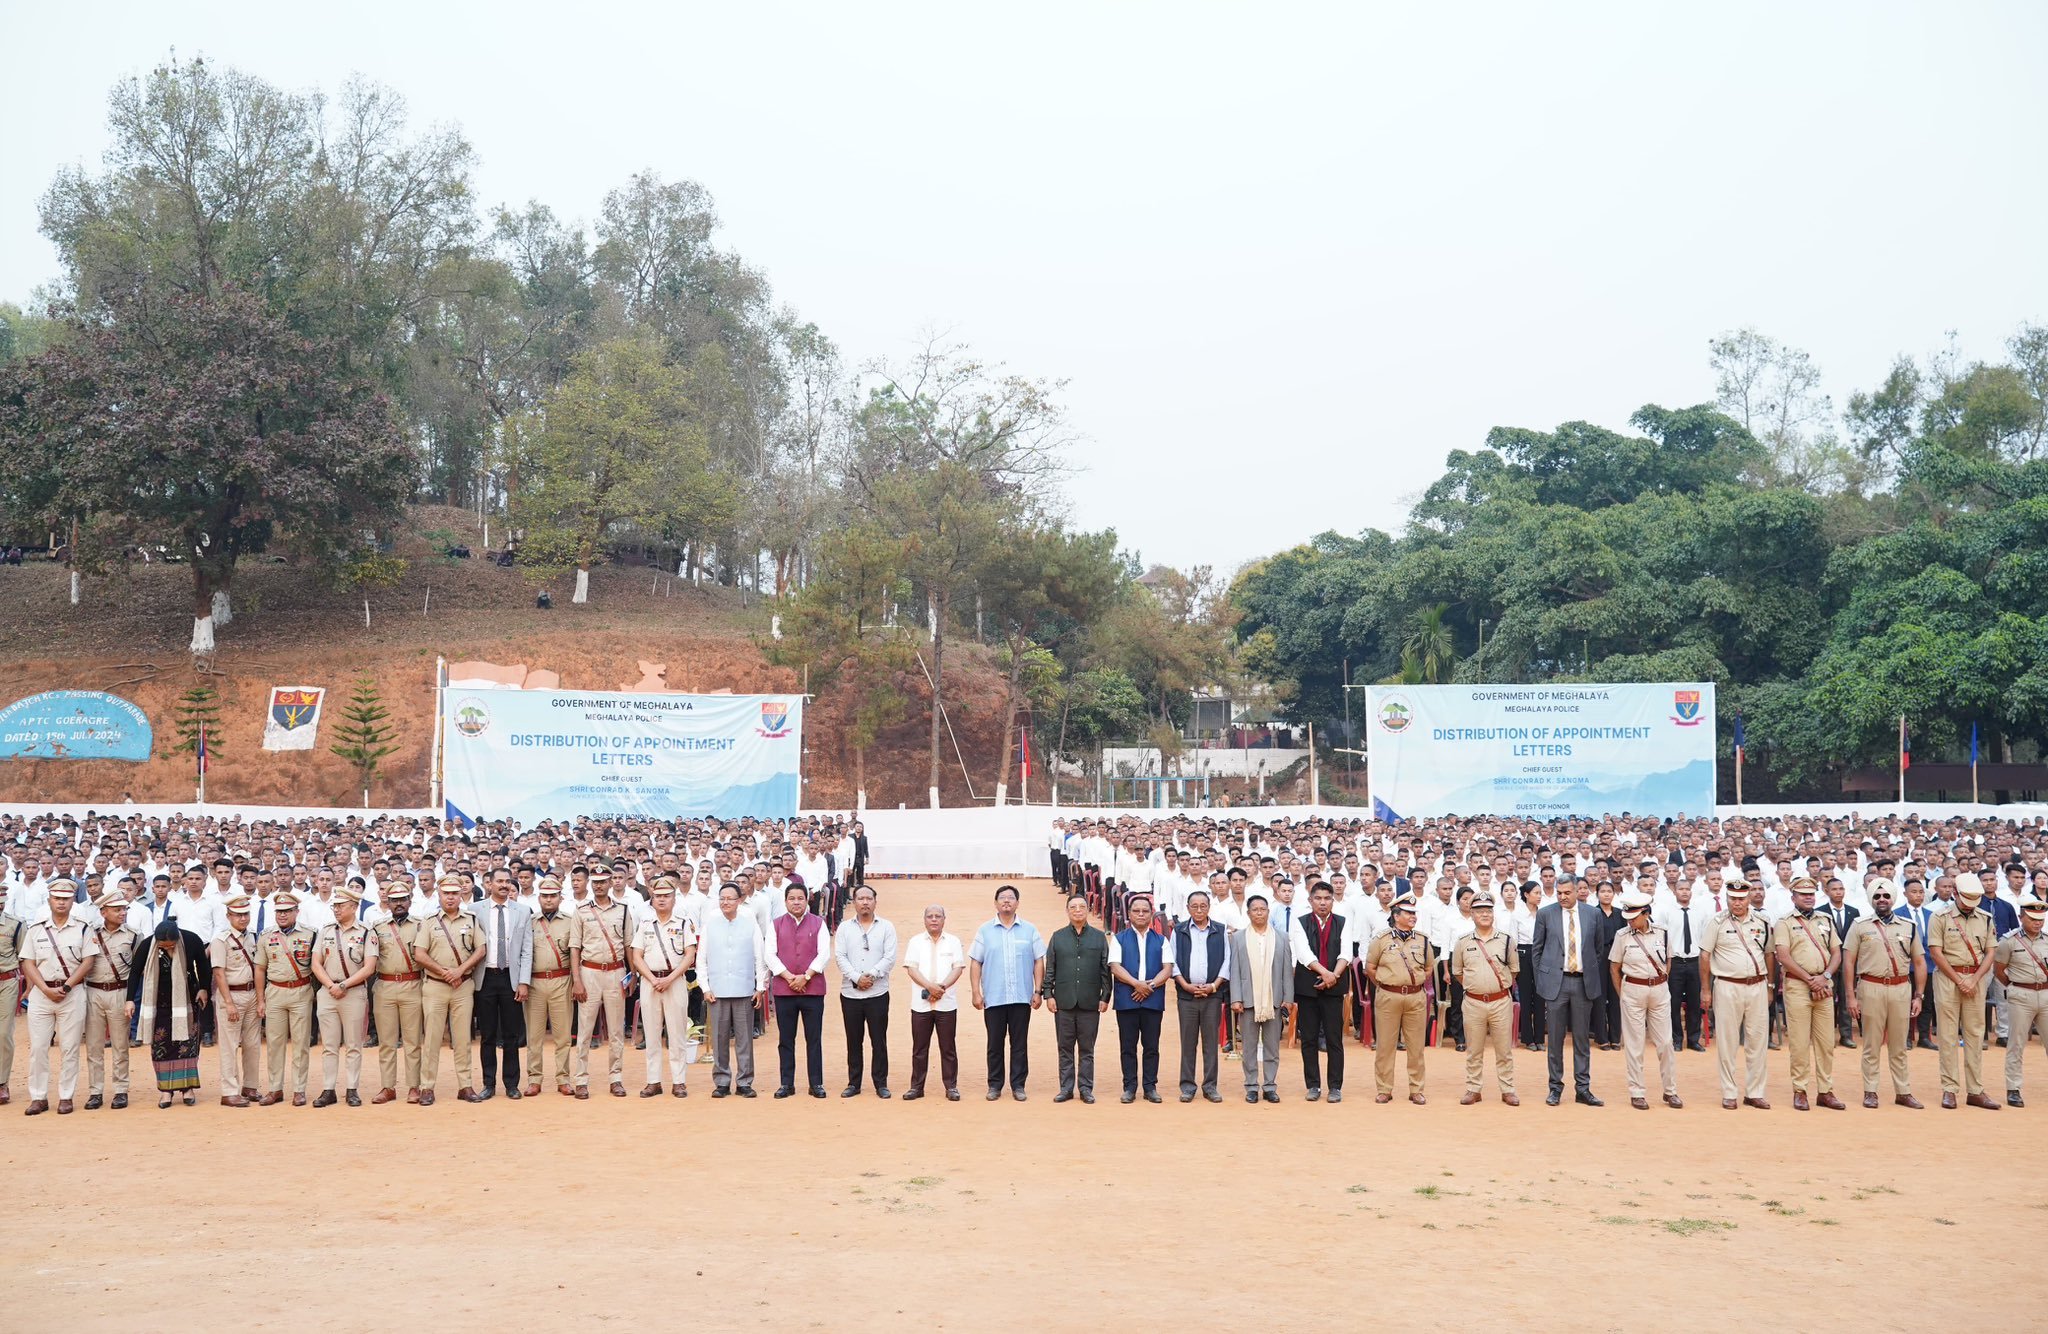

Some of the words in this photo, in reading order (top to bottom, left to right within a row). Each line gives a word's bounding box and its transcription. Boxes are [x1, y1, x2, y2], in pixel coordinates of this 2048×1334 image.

[1471, 692, 1535, 701] GOVERNMENT
[1537, 692, 1549, 700] OF
[1551, 692, 1610, 700] MEGHALAYA
[64, 691, 104, 699] PASSING
[105, 695, 124, 706] OUT
[121, 702, 147, 726] PARADE
[551, 699, 617, 709] GOVERNMENT
[619, 700, 631, 709] OF
[633, 701, 693, 710] MEGHALAYA
[19, 717, 50, 726] APTC
[55, 716, 111, 725] GOERAGRE
[585, 713, 633, 722] MEGHALAYA
[635, 714, 662, 722] POLICE
[94, 731, 122, 740] 2024
[1433, 728, 1528, 740] DISTRIBUTION
[1531, 727, 1549, 739] OF
[1553, 727, 1651, 739] APPOINTMENT
[510, 734, 608, 747] DISTRIBUTION
[611, 736, 630, 748] OF
[633, 737, 735, 750] APPOINTMENT
[1513, 744, 1572, 756] LETTERS
[592, 753, 653, 766] LETTERS
